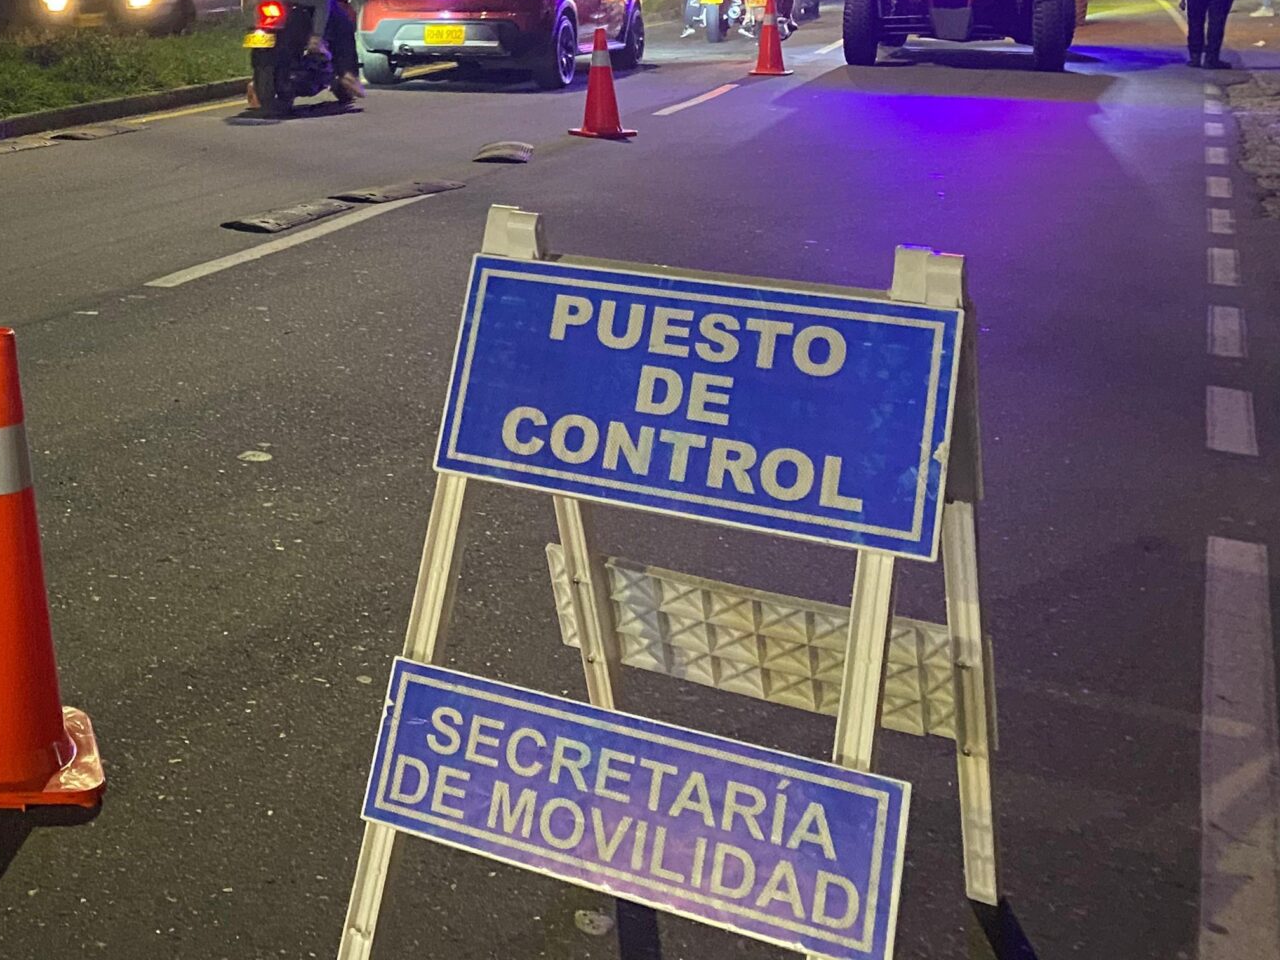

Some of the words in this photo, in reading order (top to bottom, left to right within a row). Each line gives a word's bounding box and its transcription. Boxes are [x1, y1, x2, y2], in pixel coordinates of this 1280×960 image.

[549, 295, 848, 377] PUESTO
[635, 365, 735, 426] DE
[501, 406, 864, 513] CONTROL
[426, 704, 839, 860] SECRETARÍA
[390, 754, 472, 816] DE
[486, 779, 861, 930] MOVILIDAD
